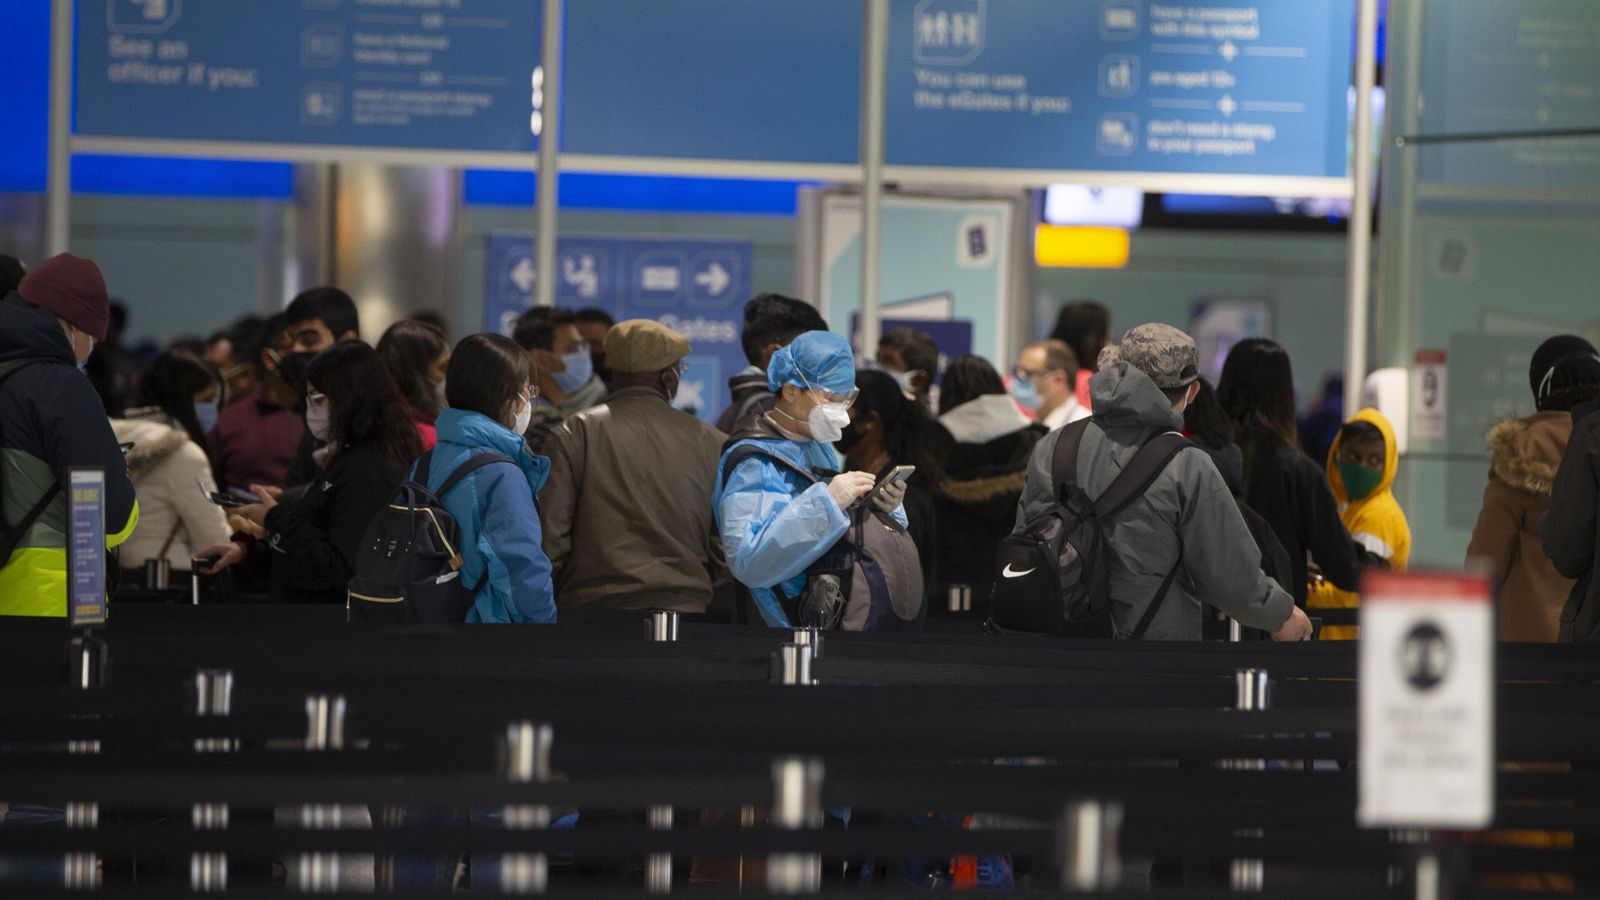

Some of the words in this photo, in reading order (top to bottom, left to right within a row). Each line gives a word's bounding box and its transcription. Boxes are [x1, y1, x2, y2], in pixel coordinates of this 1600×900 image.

[110, 35, 152, 56] See
[159, 42, 187, 58] an
[109, 63, 182, 83] officer
[915, 68, 949, 87] You
[956, 74, 987, 88] can
[992, 75, 1025, 89] use
[915, 91, 943, 107] the
